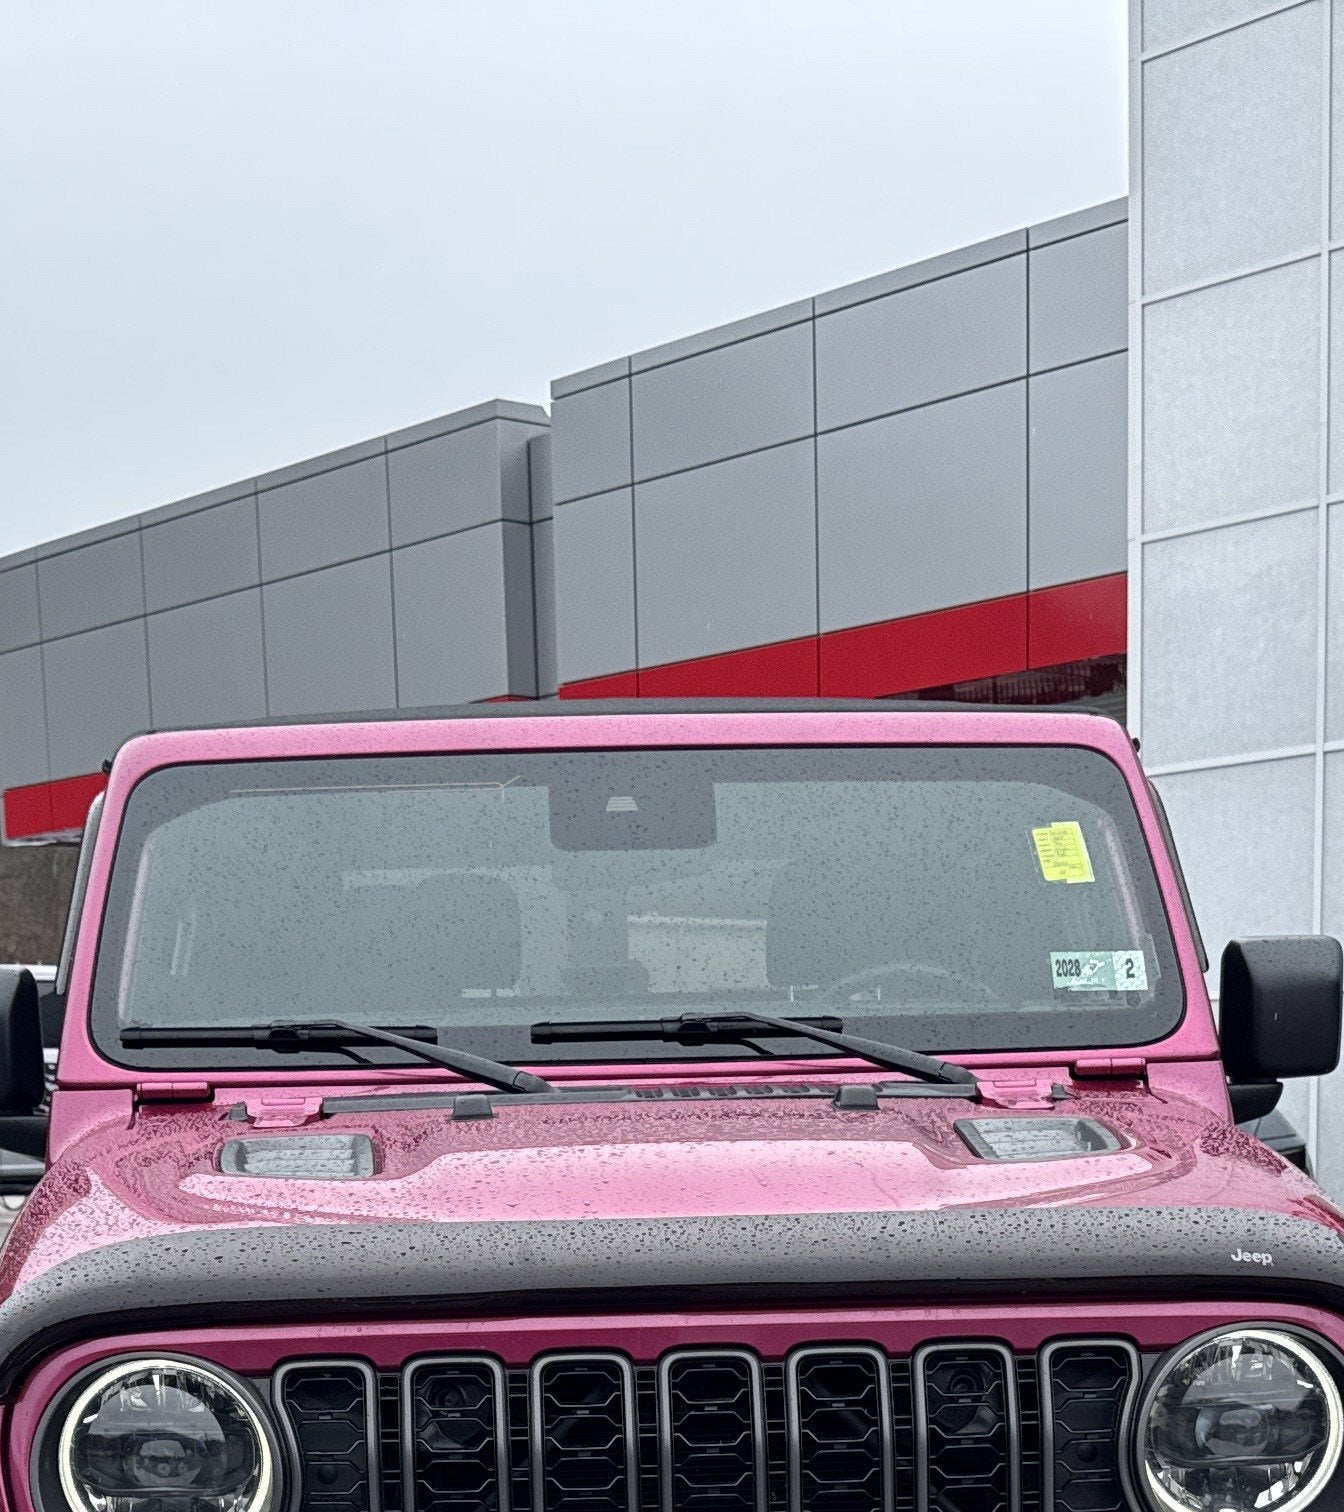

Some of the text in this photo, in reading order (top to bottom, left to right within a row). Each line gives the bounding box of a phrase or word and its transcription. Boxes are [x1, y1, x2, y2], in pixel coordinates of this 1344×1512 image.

[1056, 957, 1136, 979] 2028 2
[1230, 1248, 1273, 1266] Jeep
